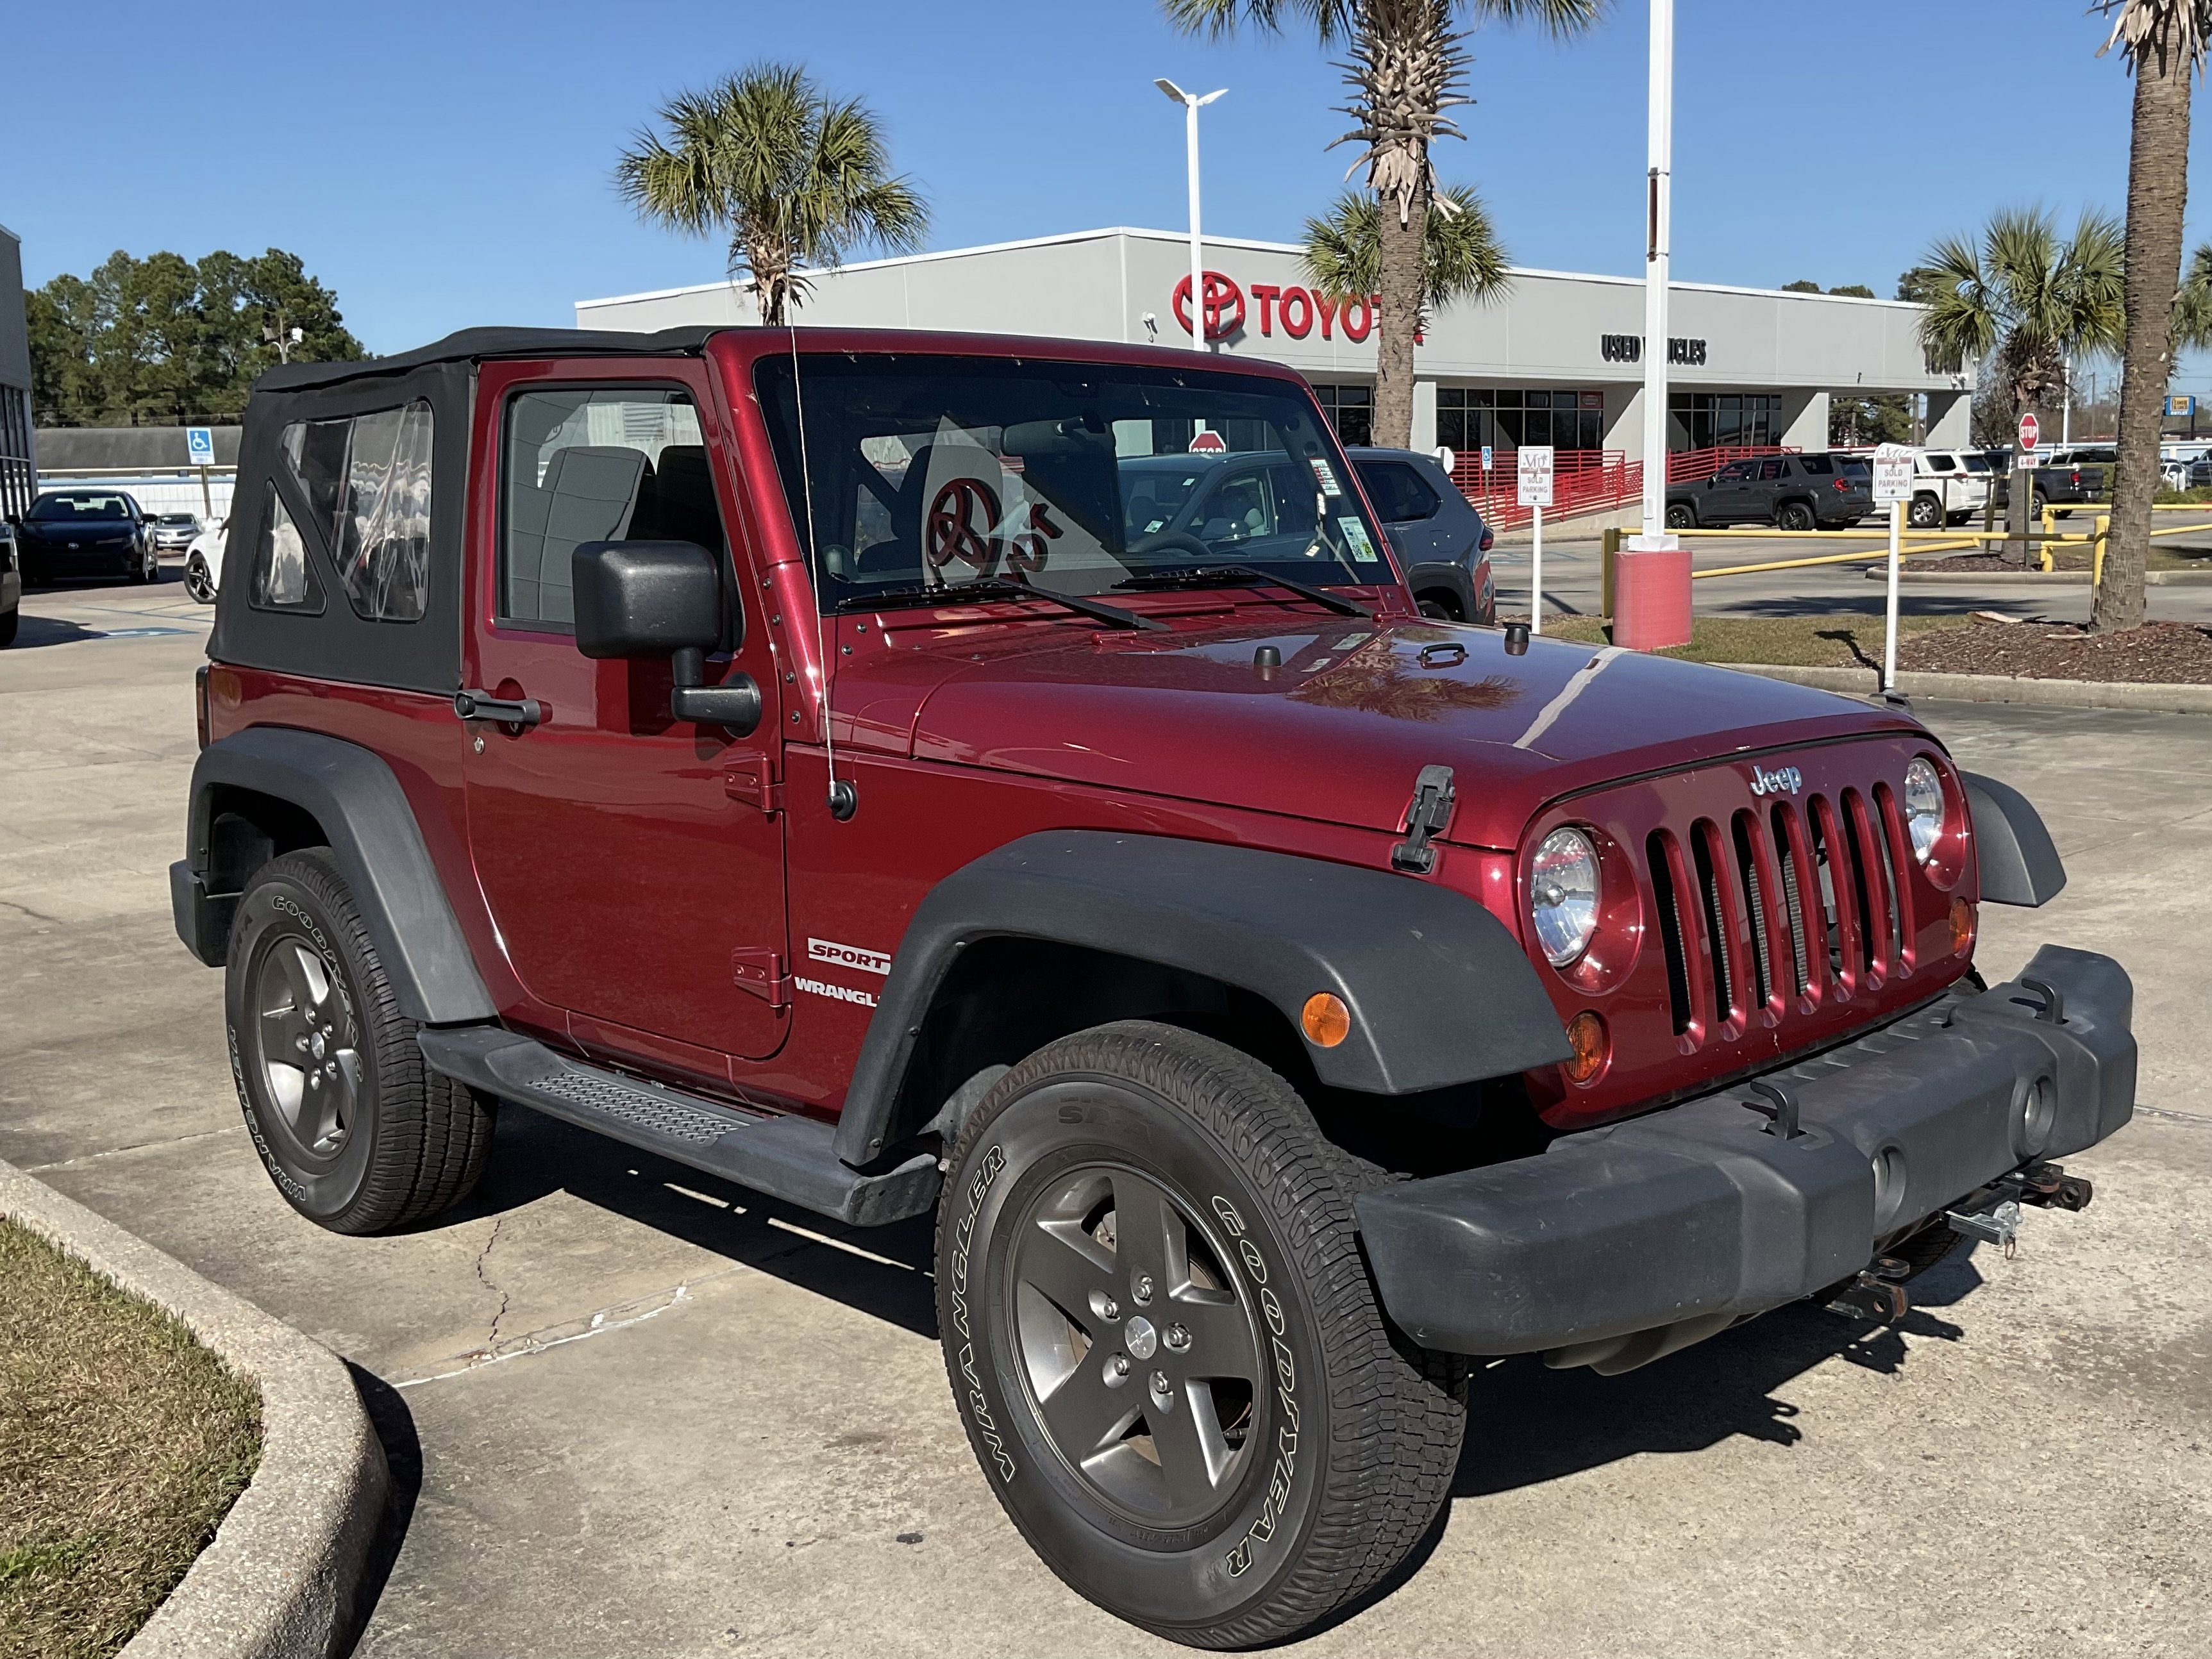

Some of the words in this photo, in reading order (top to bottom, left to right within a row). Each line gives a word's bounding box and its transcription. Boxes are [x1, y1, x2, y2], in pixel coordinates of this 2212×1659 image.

[1250, 284, 1424, 346] TOYO
[1602, 335, 1640, 362] USED
[1643, 337, 1706, 365] ICLES
[2020, 426, 2037, 438] STOP
[1884, 469, 1902, 477] SOLD
[2020, 458, 2036, 467] 4-WAY
[1749, 765, 1802, 796] Jeep
[809, 944, 891, 969] SPORT
[272, 896, 364, 1083] GOODYEAR
[794, 976, 880, 1007] WRANGL
[228, 1024, 306, 1201] WRANGLER
[951, 1145, 1016, 1482] WRANGLER
[1211, 1196, 1299, 1578] GOODYEAR
